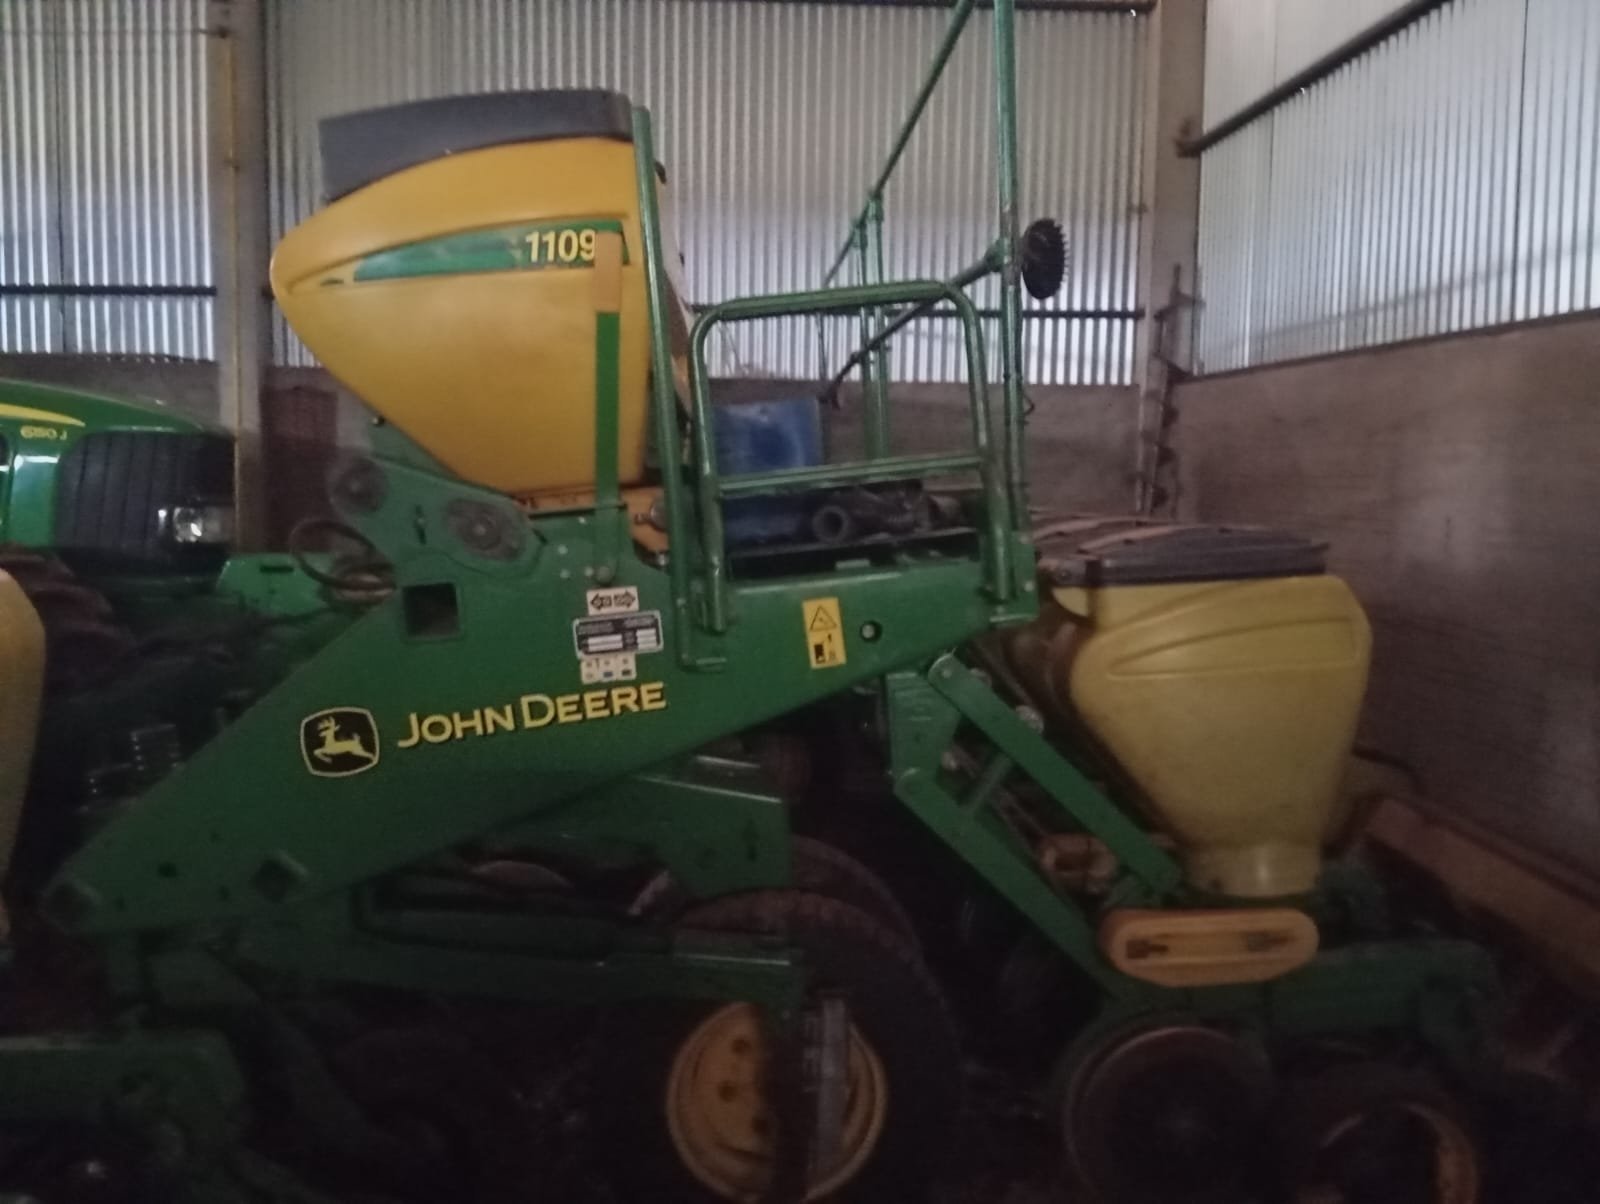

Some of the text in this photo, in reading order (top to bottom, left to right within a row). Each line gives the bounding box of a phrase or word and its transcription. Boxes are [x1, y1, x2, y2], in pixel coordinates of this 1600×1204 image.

[525, 229, 596, 263] 1109
[397, 682, 667, 748] JOHN DEERE
